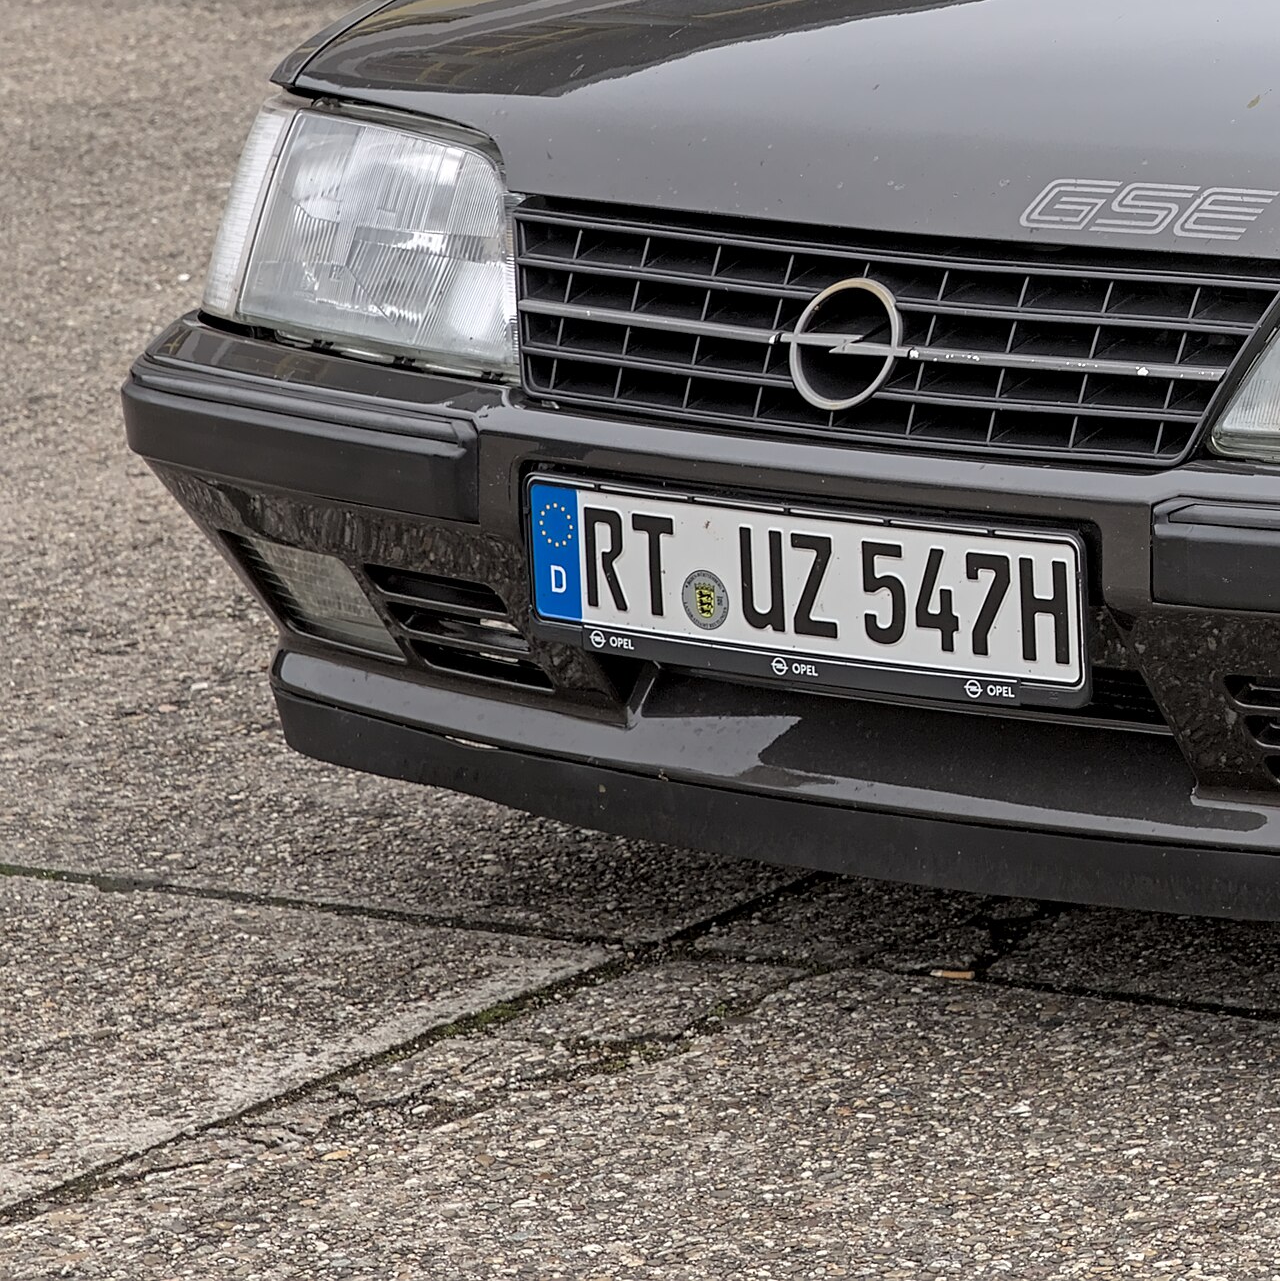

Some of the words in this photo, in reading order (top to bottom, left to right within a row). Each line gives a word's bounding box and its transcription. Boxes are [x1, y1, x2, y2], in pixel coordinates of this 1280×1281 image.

[1019, 177, 1280, 241] GSE
[550, 565, 567, 594] D
[582, 506, 675, 617] RT
[738, 525, 839, 639] UZ
[860, 539, 1070, 666] 547H
[608, 636, 635, 651] OPEL
[791, 662, 819, 677] OPEL
[985, 684, 1015, 699] OPEL
